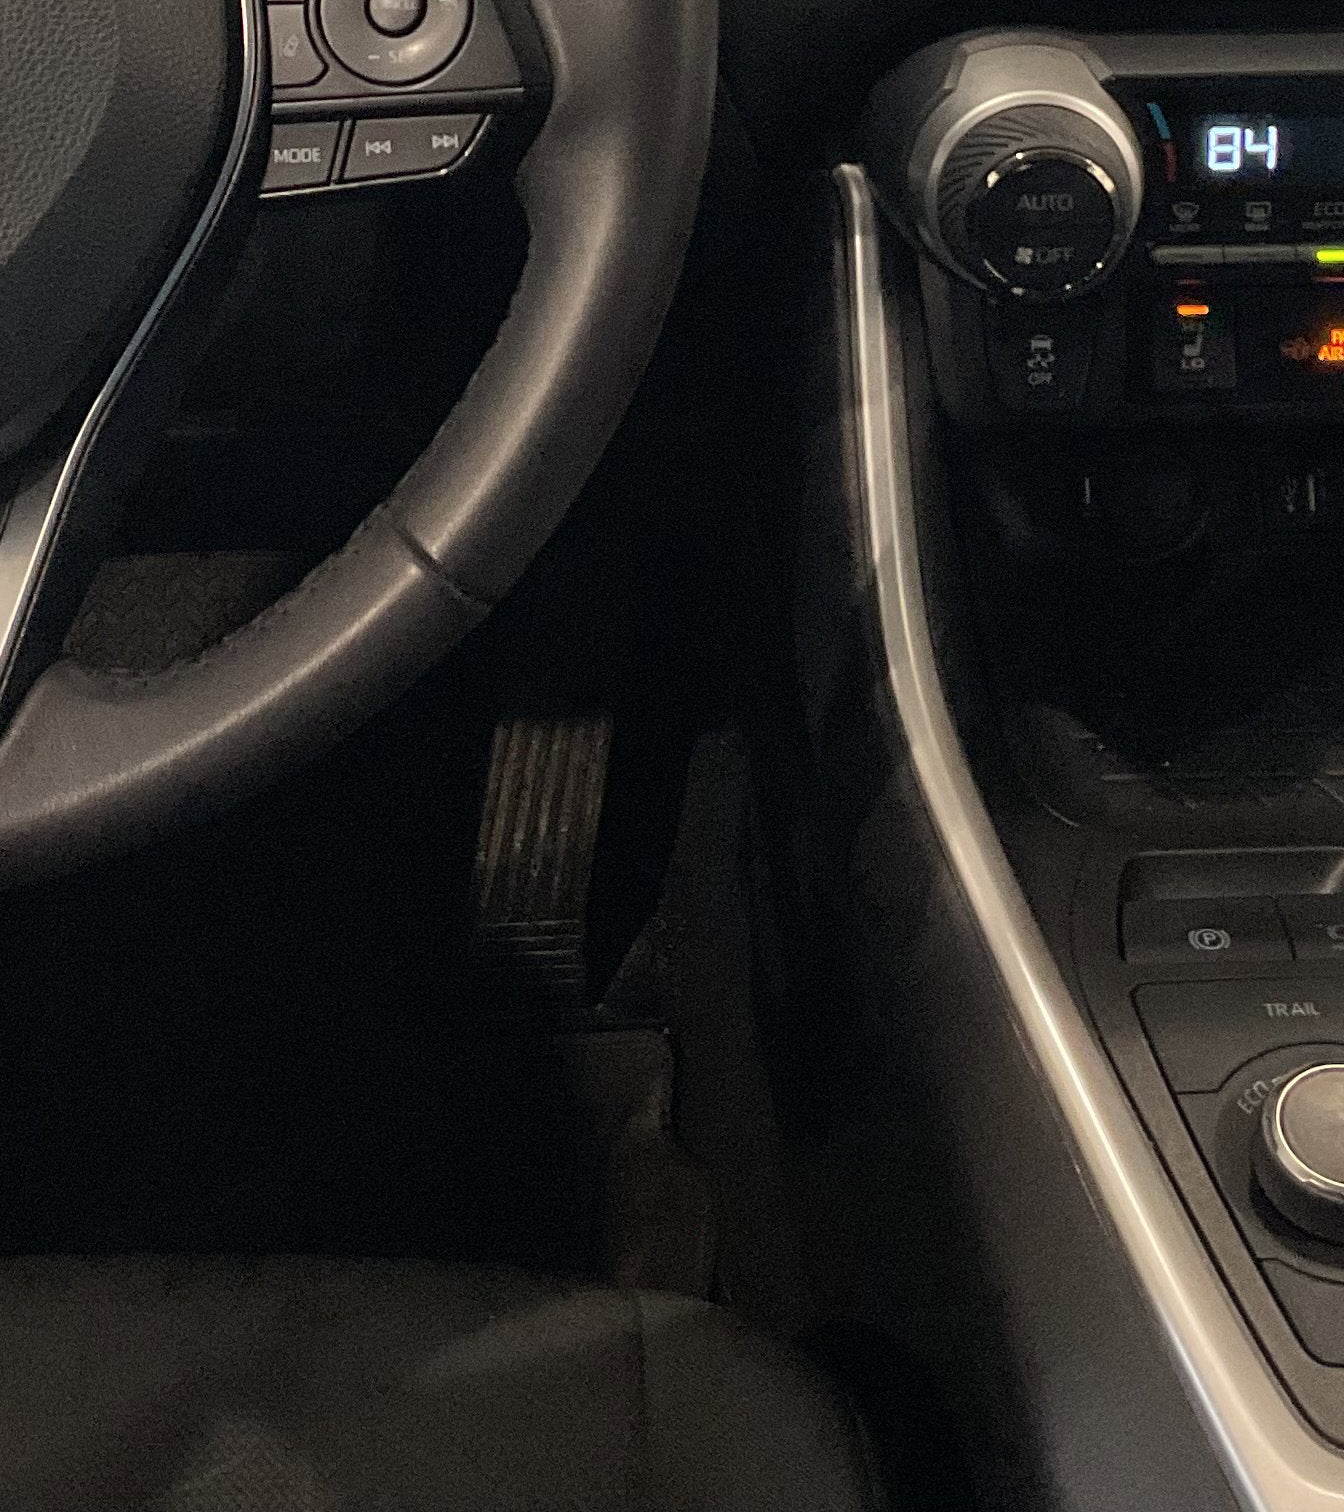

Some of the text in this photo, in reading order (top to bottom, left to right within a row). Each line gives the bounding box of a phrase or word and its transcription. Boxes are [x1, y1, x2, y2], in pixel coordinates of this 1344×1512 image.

[273, 146, 321, 164] MODE
[1206, 125, 1278, 171] 84
[1015, 192, 1075, 212] AUTO
[1318, 345, 1344, 360] AIR
[1263, 1001, 1320, 1017] TRAIL
